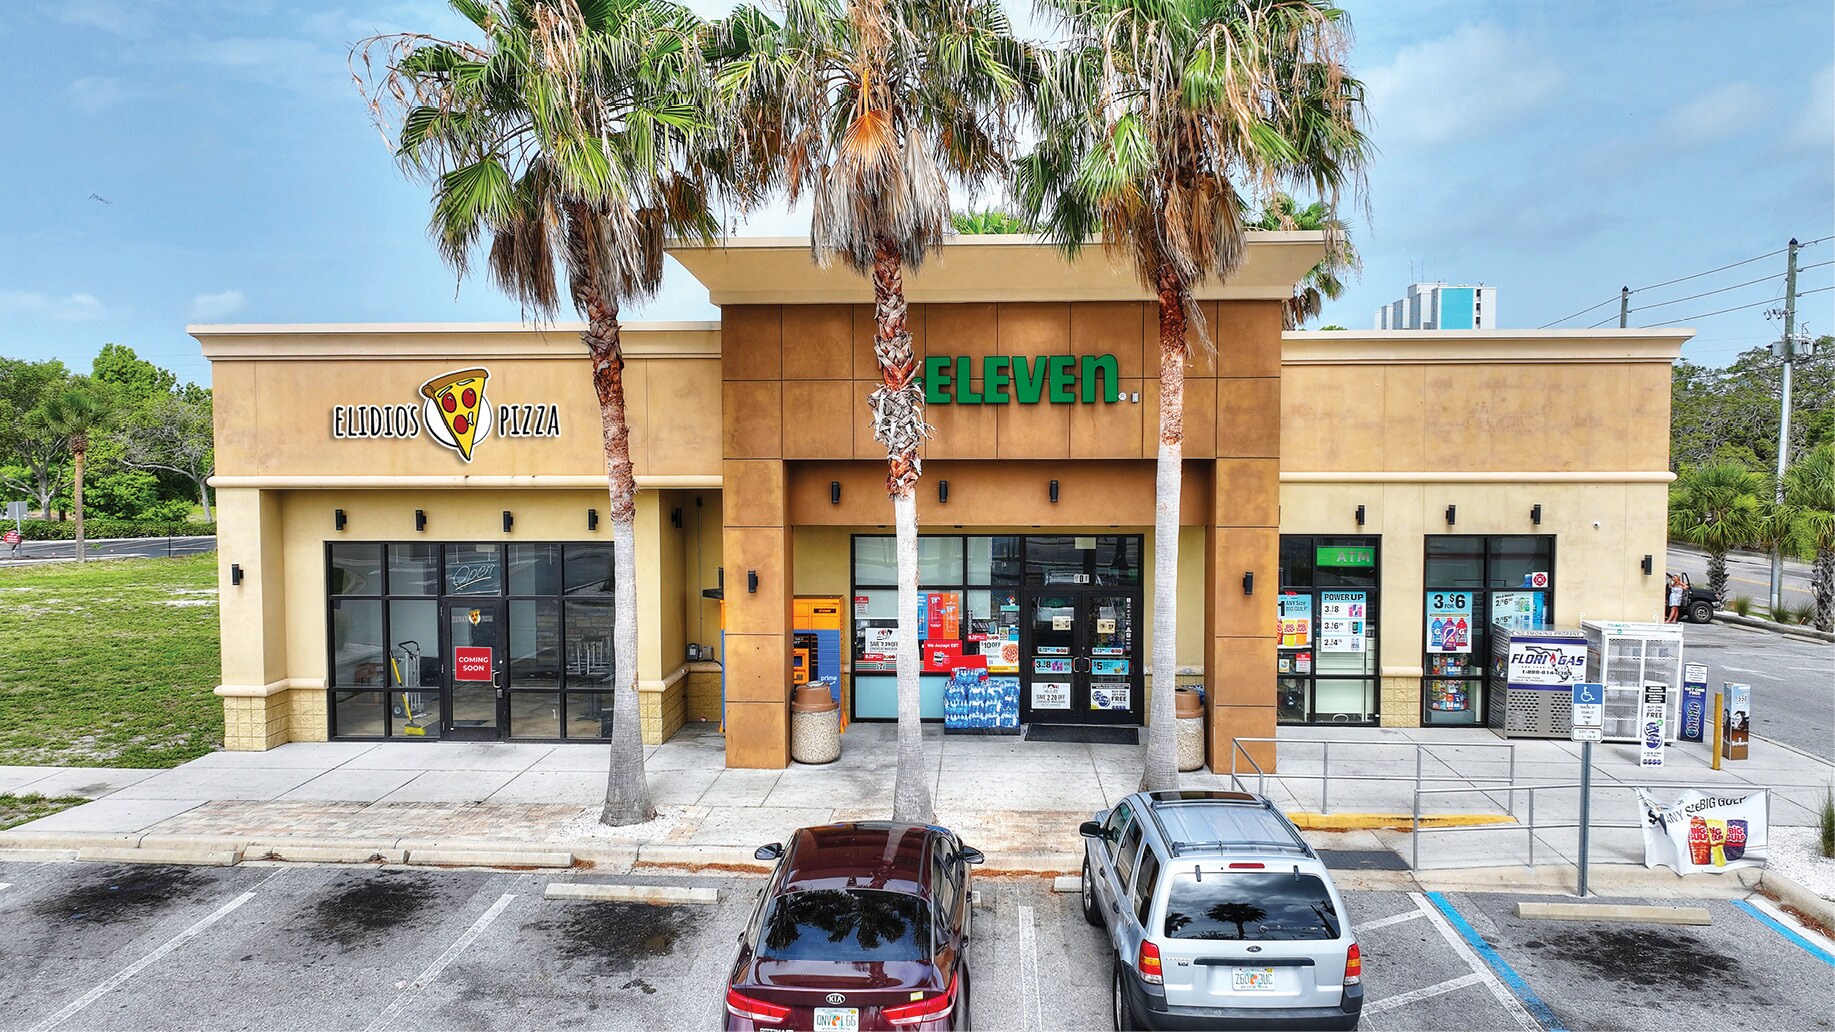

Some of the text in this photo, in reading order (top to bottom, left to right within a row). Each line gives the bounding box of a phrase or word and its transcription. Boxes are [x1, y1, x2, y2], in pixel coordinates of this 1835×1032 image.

[334, 404, 561, 438] ELIDIO'S PIZZA
[1336, 551, 1370, 563] ATM
[453, 564, 495, 587] Open
[1324, 593, 1364, 601] POWER UP
[1434, 594, 1443, 609] 3
[1510, 653, 1586, 666] FLORI GAS
[462, 664, 485, 672] SOON
[829, 995, 842, 1003] KIA
